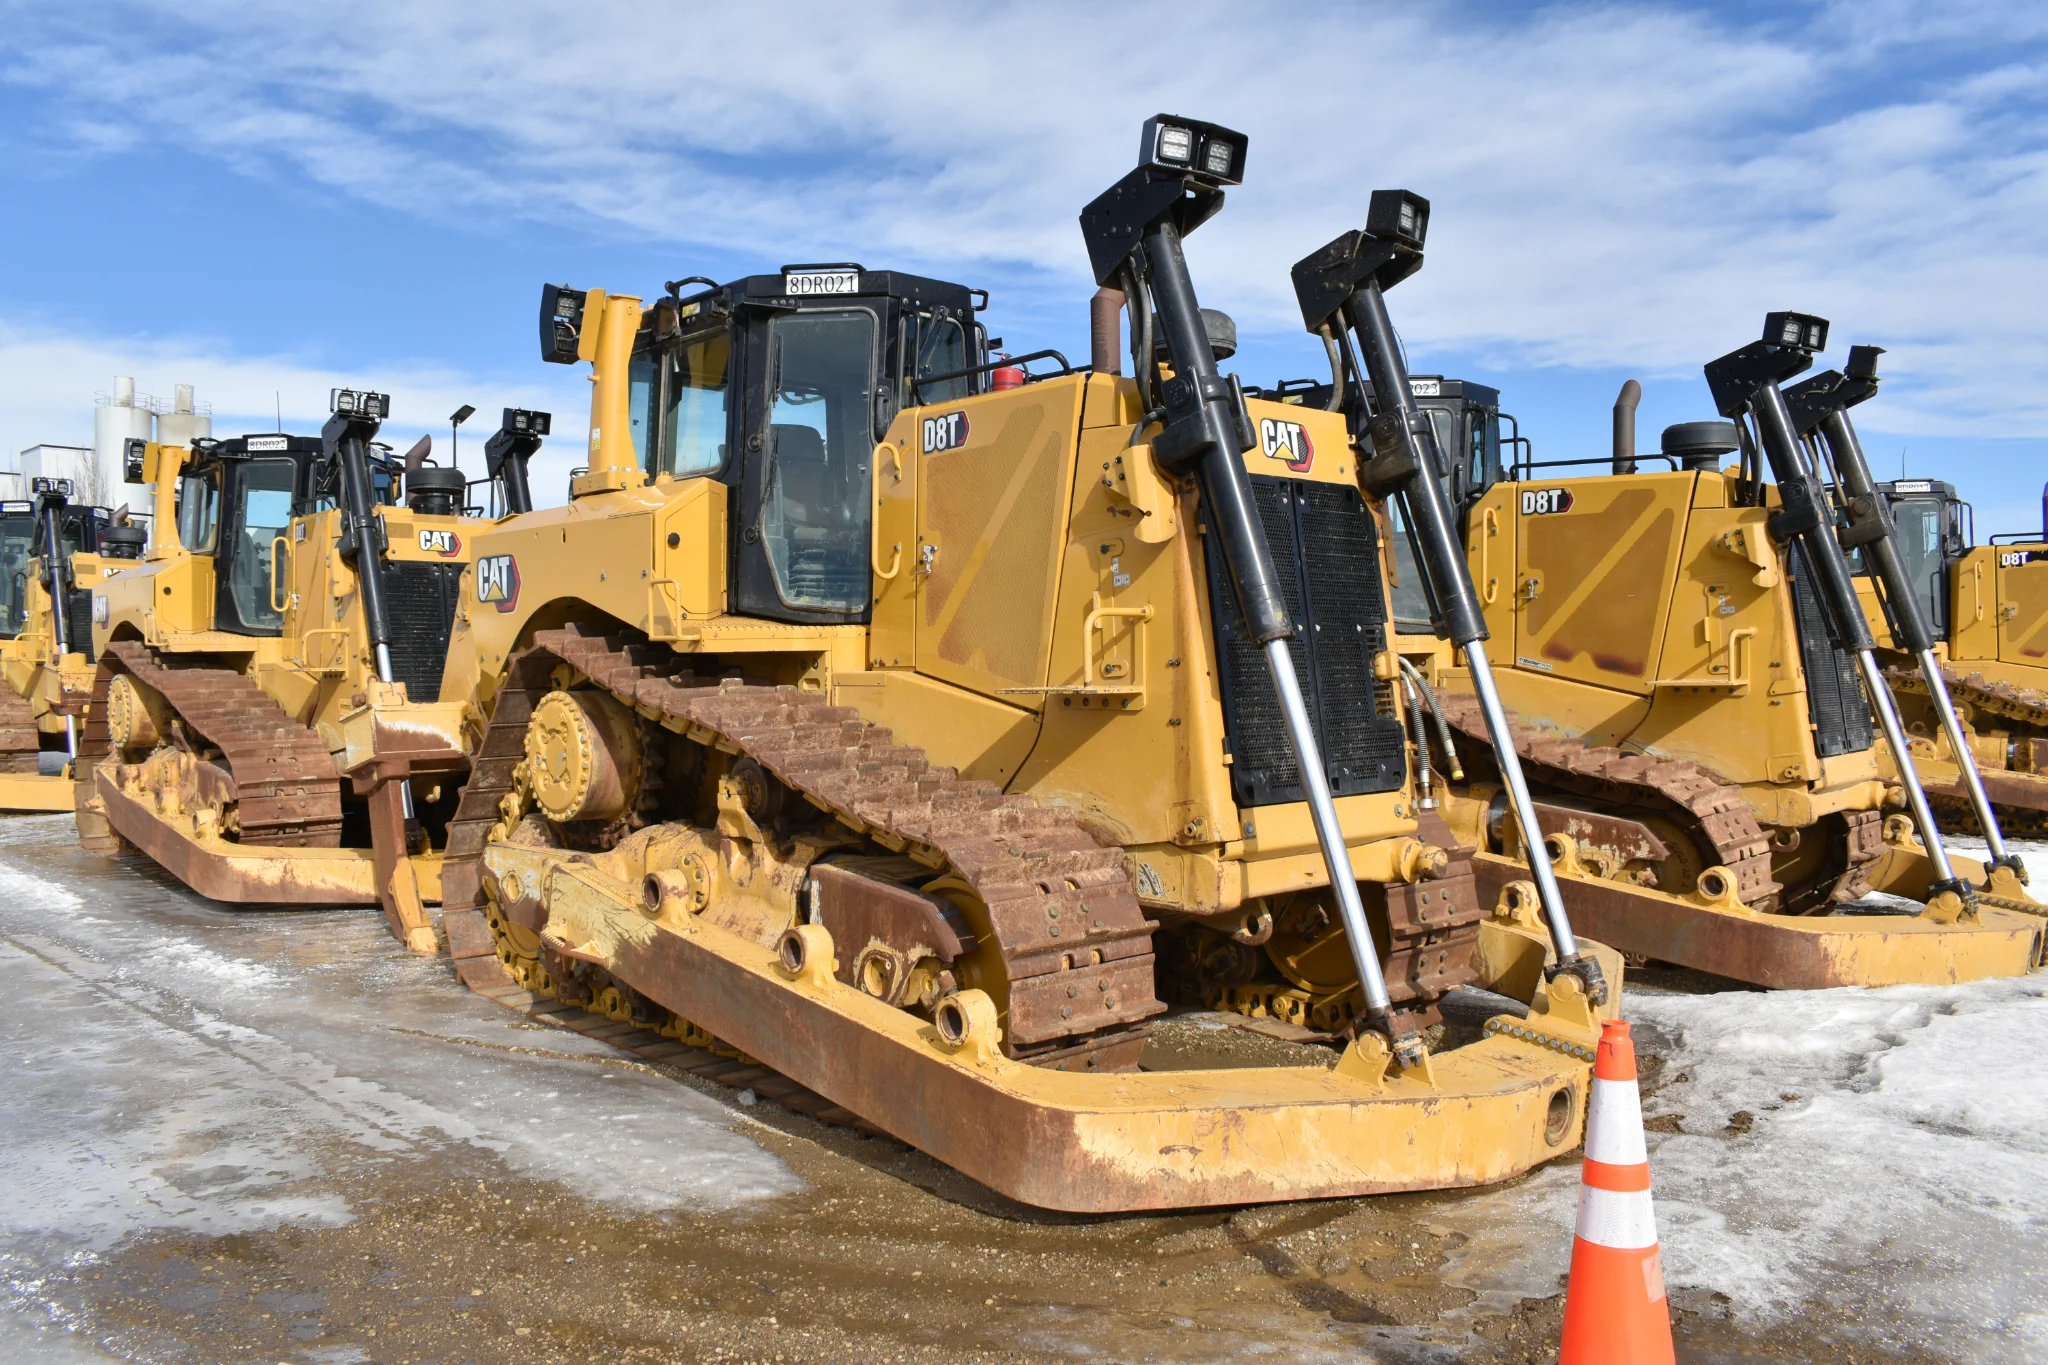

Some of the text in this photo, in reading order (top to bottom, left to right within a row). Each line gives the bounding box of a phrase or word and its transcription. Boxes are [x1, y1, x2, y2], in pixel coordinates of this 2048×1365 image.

[790, 275, 856, 293] 8DR021
[1410, 383, 1438, 394] 023
[924, 413, 959, 452] D8T
[1261, 419, 1300, 461] CAT
[249, 440, 286, 449] 8DR022
[1522, 489, 1561, 514] D8T
[419, 530, 452, 552] CAT
[2001, 551, 2028, 566] D8T
[478, 556, 509, 601] CAT
